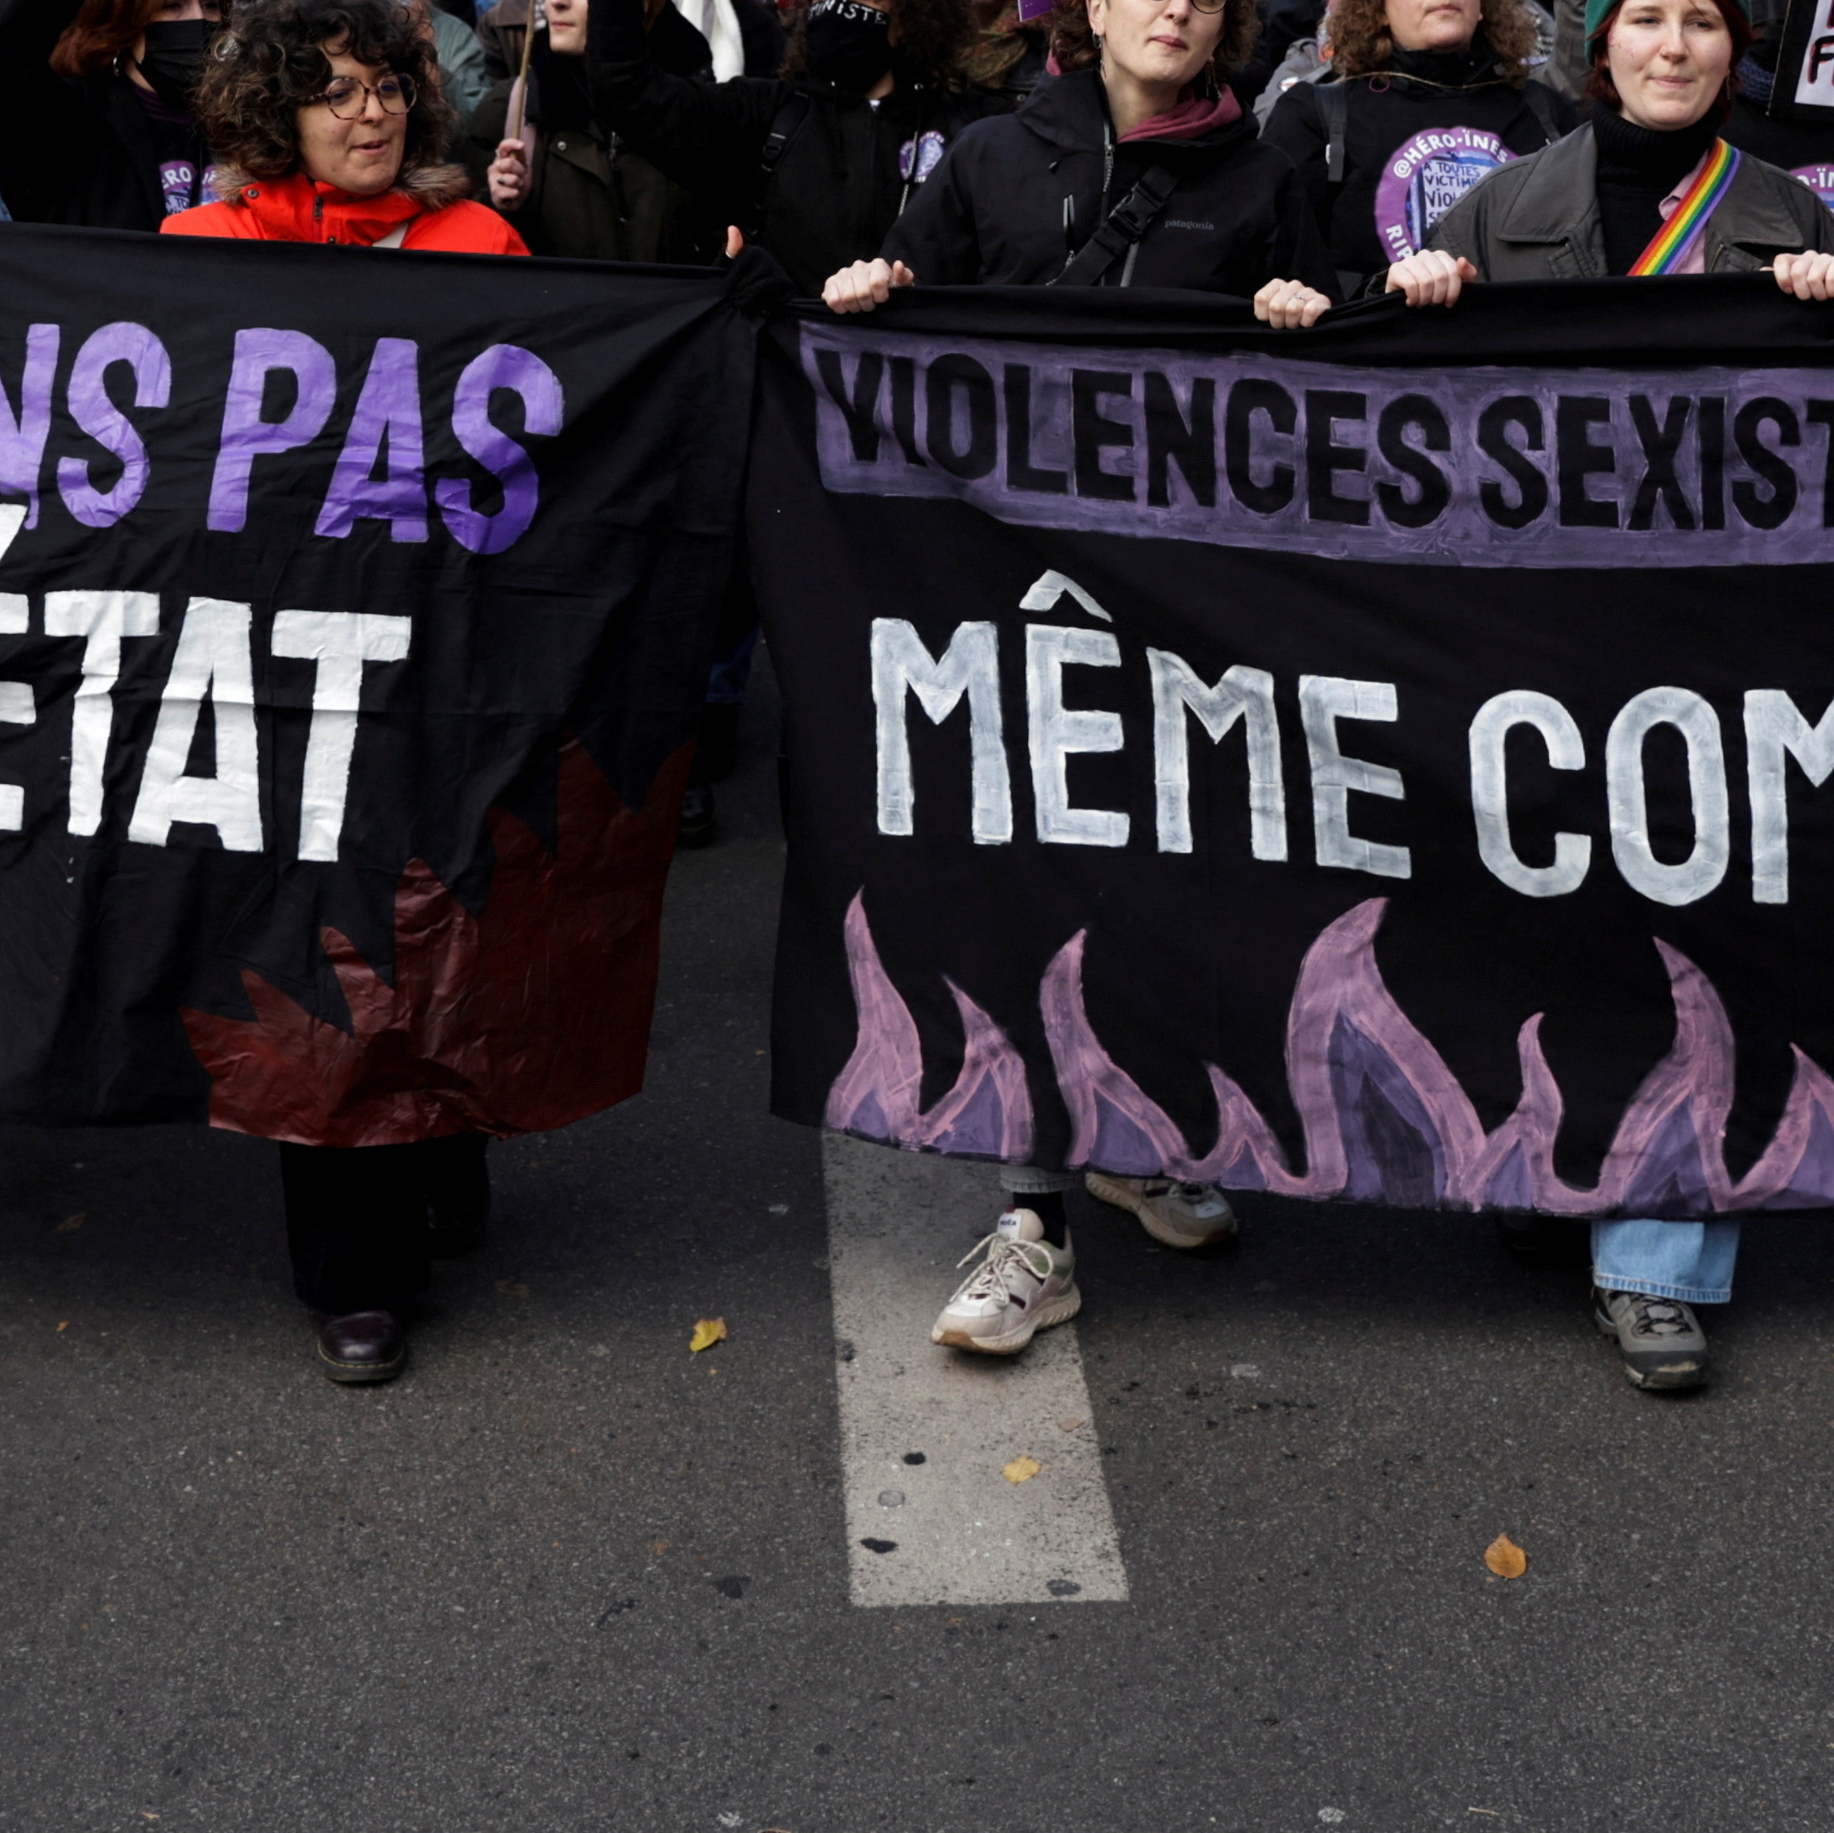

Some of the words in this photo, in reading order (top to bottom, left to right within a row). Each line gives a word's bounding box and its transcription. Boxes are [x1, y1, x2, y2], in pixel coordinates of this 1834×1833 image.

[1439, 162, 1480, 178] TOUTES
[207, 327, 567, 555] PAS
[813, 346, 1455, 529] VIOLENCES
[870, 567, 1413, 880] MÊME
